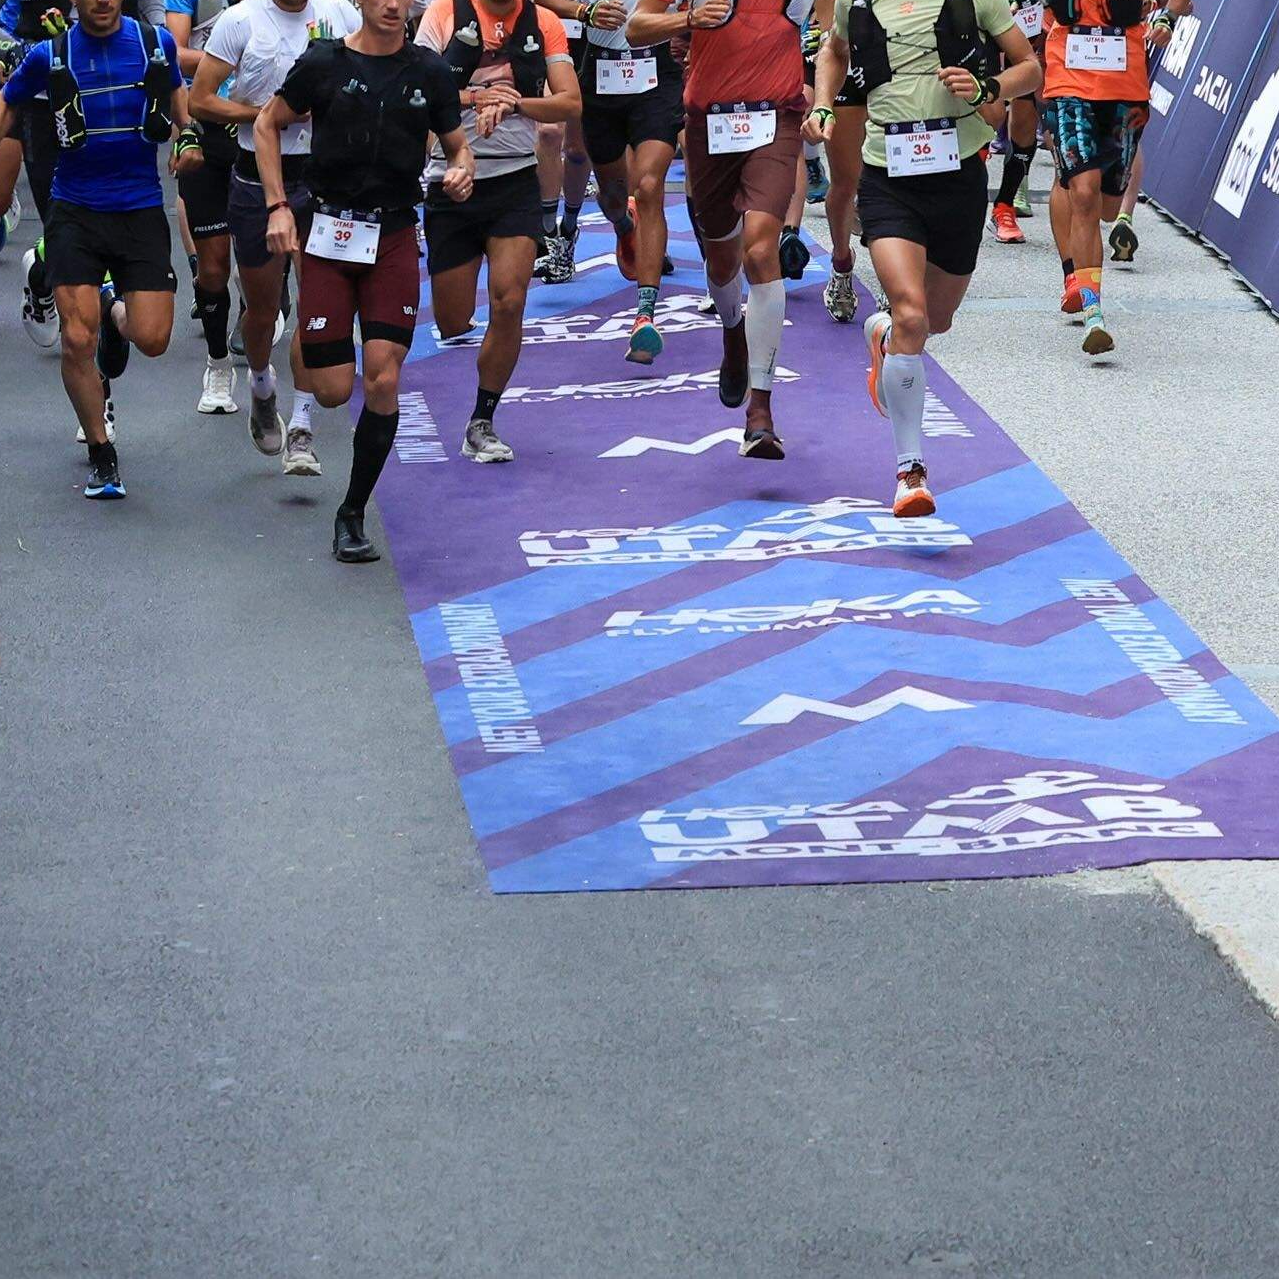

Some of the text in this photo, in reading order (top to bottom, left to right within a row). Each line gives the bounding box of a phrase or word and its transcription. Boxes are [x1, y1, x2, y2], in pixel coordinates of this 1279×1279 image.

[1022, 13, 1038, 24] 167
[1093, 44, 1099, 55] 1
[621, 68, 634, 79] 12
[733, 123, 750, 134] 50
[913, 144, 931, 155] 36
[334, 230, 352, 242] 39
[518, 524, 732, 540] HOKA
[603, 589, 982, 628] HOKA
[605, 626, 675, 638] FLY
[681, 613, 893, 636] HUMAN
[639, 800, 910, 822] HOKA
[639, 794, 1204, 844] UTMB
